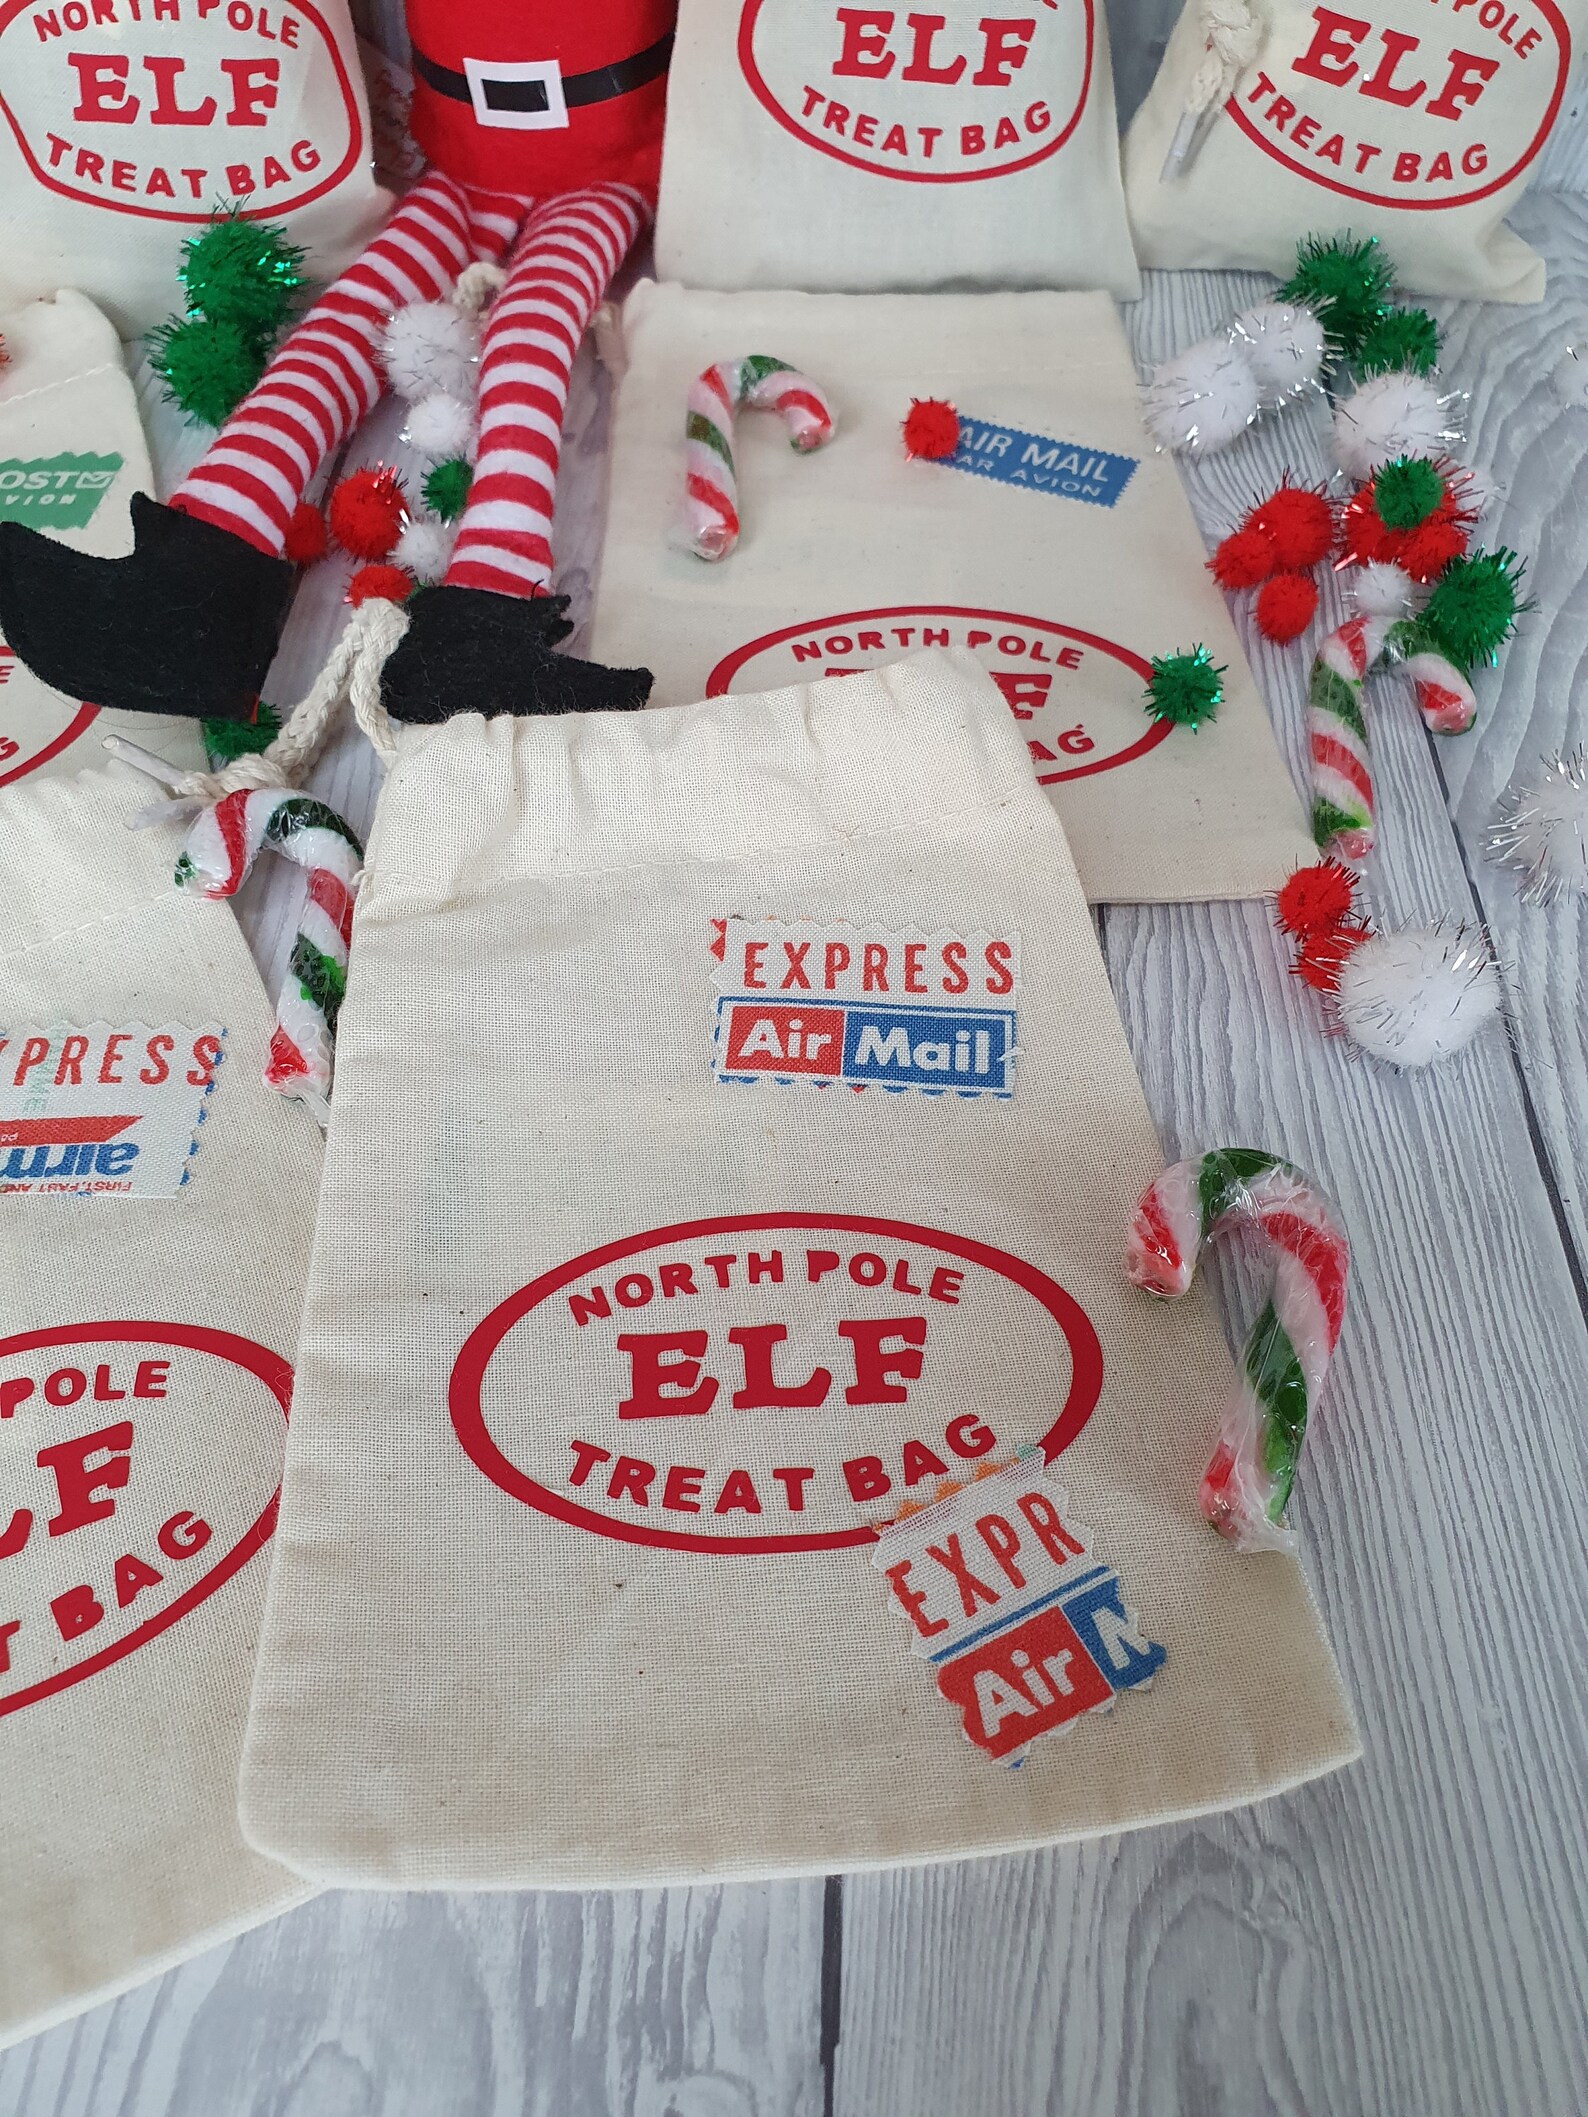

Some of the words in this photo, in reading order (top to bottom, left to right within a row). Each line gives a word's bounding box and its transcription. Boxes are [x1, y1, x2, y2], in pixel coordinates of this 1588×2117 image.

[33, 0, 180, 42] NORTH
[198, 0, 299, 49] POLE
[832, 8, 1036, 86] ELF
[68, 52, 280, 126] ELF
[1291, 6, 1500, 121] ELF
[802, 85, 943, 158] TREAT
[960, 101, 1051, 155] BAG
[1247, 71, 1382, 174] TREAT
[1393, 143, 1488, 183] BAG
[46, 132, 208, 198] TREAT
[225, 140, 321, 196] BAG
[957, 426, 1013, 457] AIR
[1020, 443, 1109, 482] MAIL
[1009, 468, 1101, 497] AVION
[791, 627, 949, 662] NORTH
[967, 631, 1084, 670] POLE
[1026, 723, 1096, 762] AG
[743, 941, 1014, 994] EXPRESS
[0, 1034, 221, 1086] PRESS
[738, 1019, 832, 1060] Air
[855, 1025, 990, 1074] Mail
[568, 1250, 784, 1326] NORTH
[807, 1250, 965, 1305] POLE
[0, 1361, 170, 1418] POLE
[618, 1317, 928, 1419] ELF
[568, 1440, 815, 1514] TREAT
[843, 1414, 998, 1502] BAG
[50, 1510, 212, 1641] BAG
[885, 1492, 1085, 1638] EXPR
[973, 1648, 1075, 1738] Air
